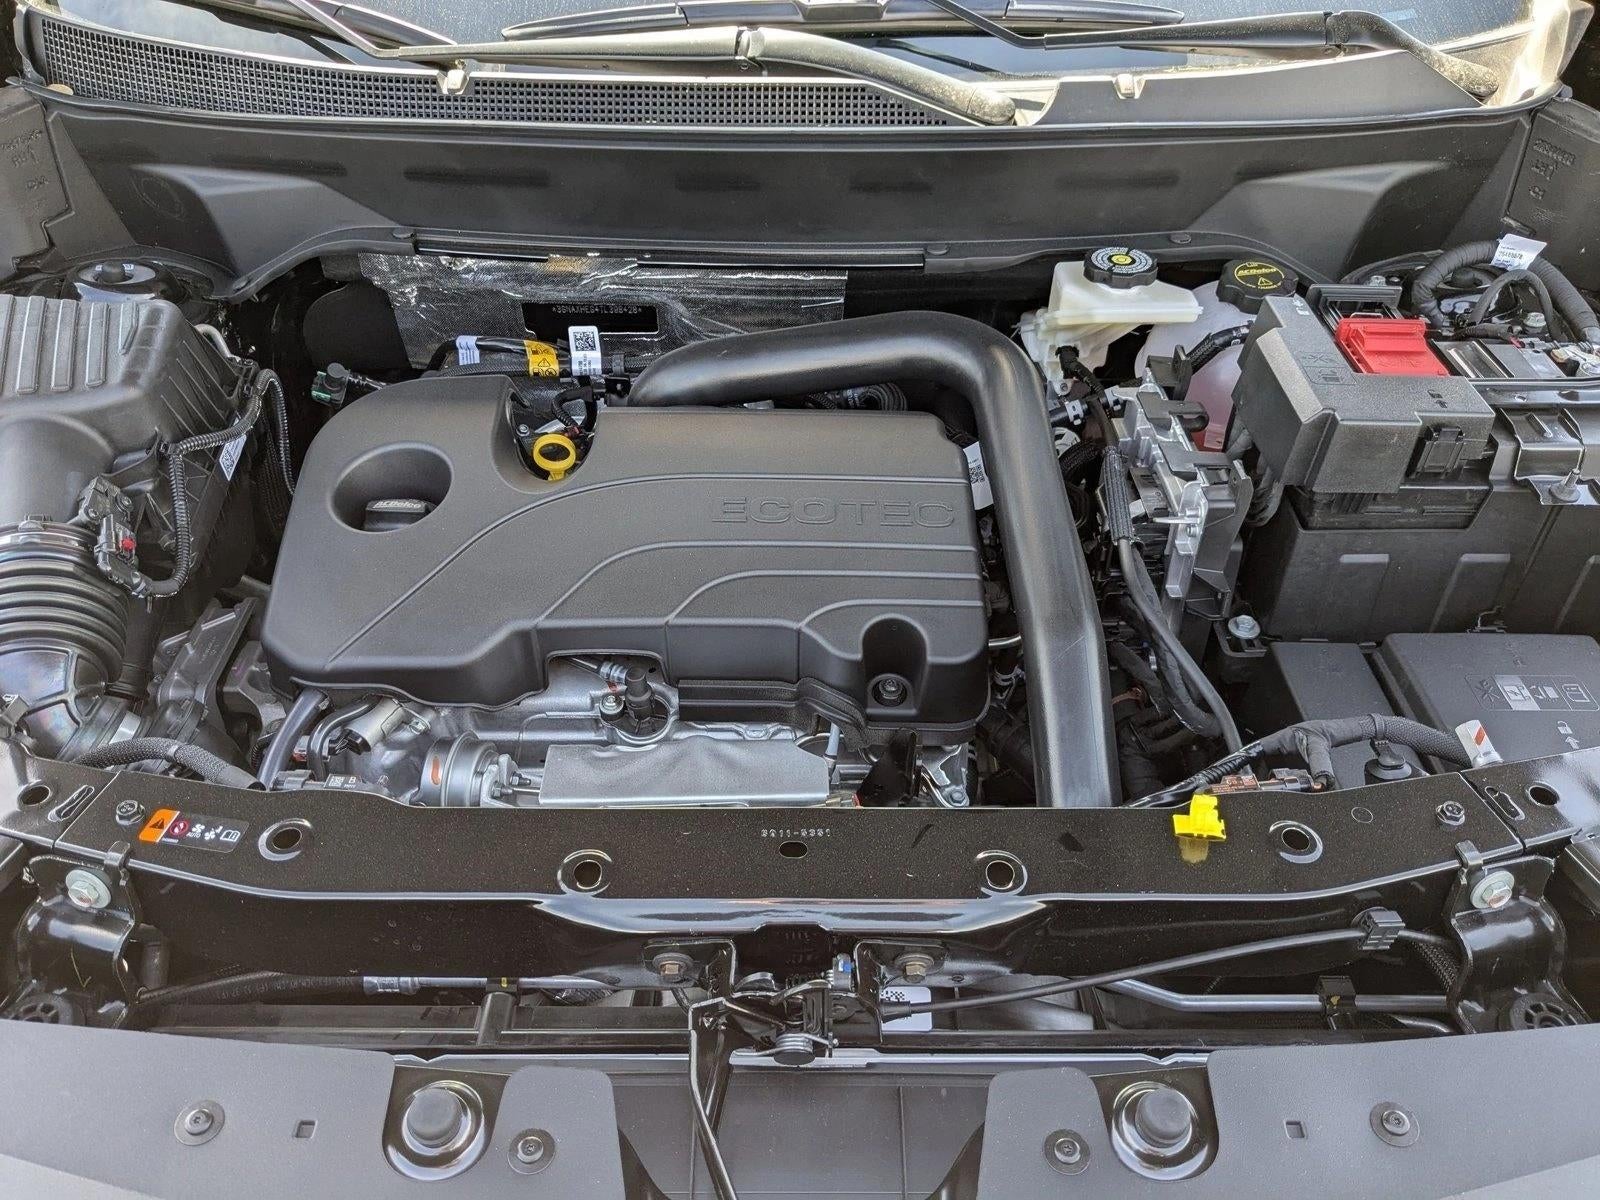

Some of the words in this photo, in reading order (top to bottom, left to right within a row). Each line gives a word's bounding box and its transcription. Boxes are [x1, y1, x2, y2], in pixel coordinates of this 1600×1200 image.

[372, 501, 422, 509] ACDelco
[711, 497, 956, 528] ECOTEC
[186, 831, 202, 839] AUTO
